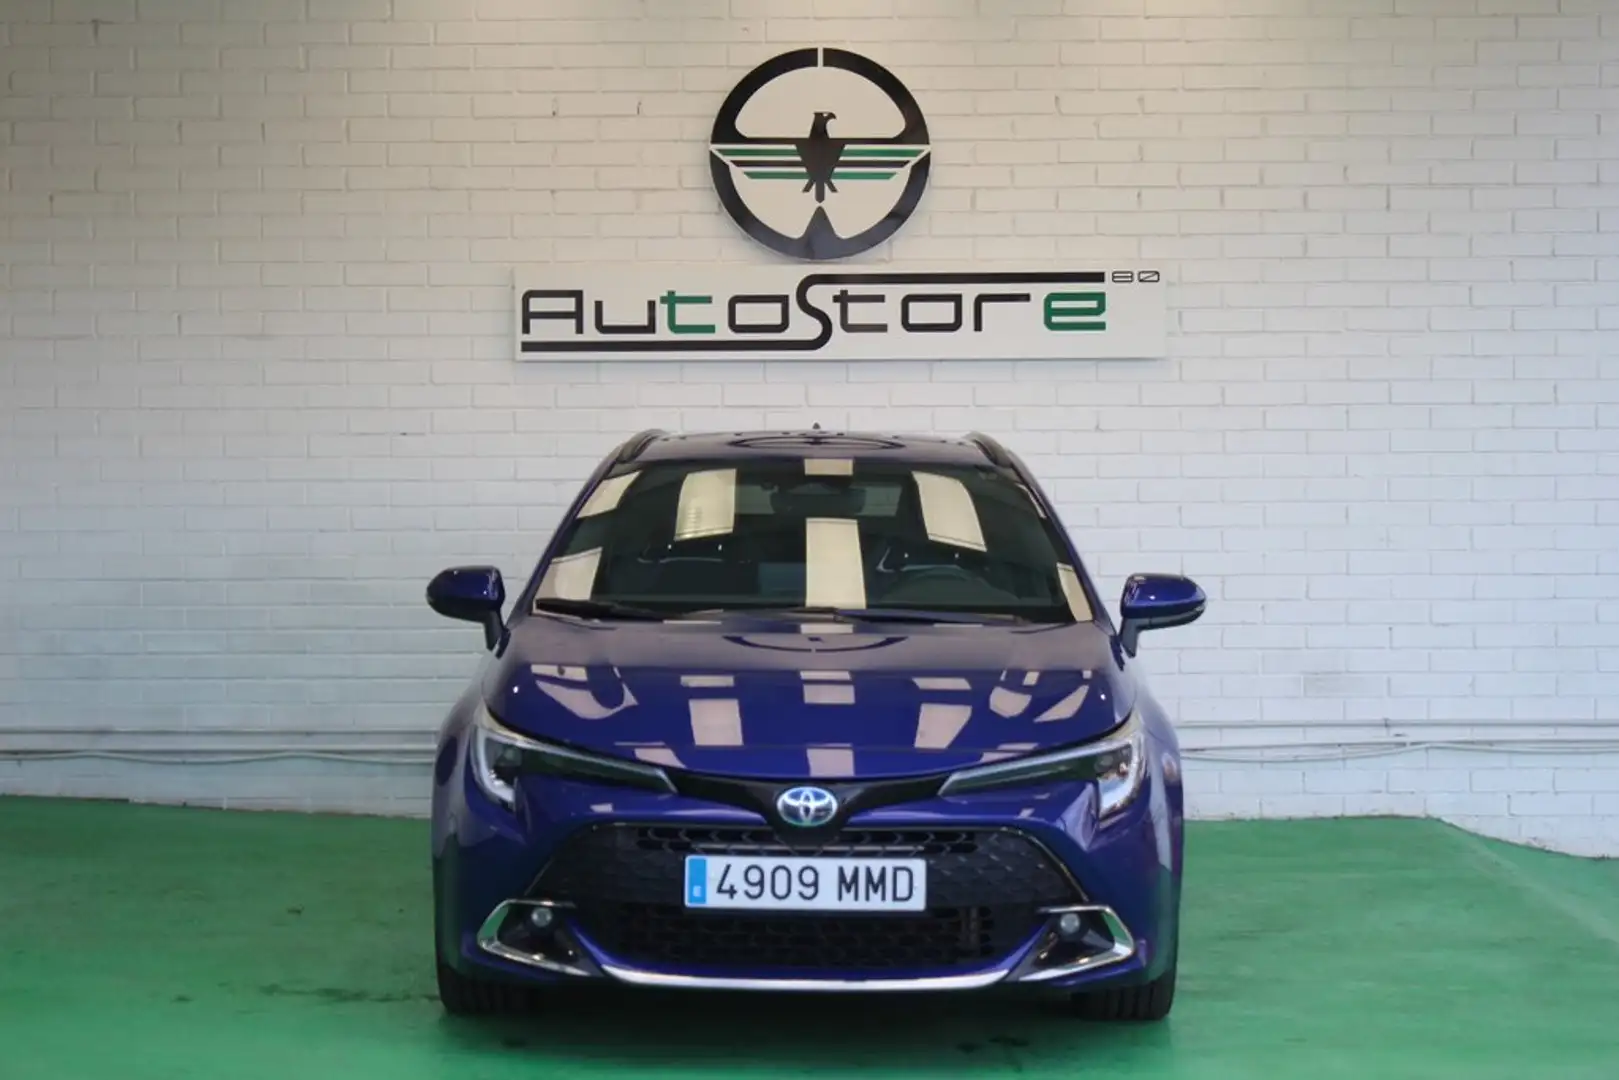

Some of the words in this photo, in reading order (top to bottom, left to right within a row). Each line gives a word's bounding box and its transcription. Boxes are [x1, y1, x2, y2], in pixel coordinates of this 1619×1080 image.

[521, 272, 1106, 351] AutoStore
[716, 864, 819, 900] 4909
[837, 866, 914, 902] MMD
